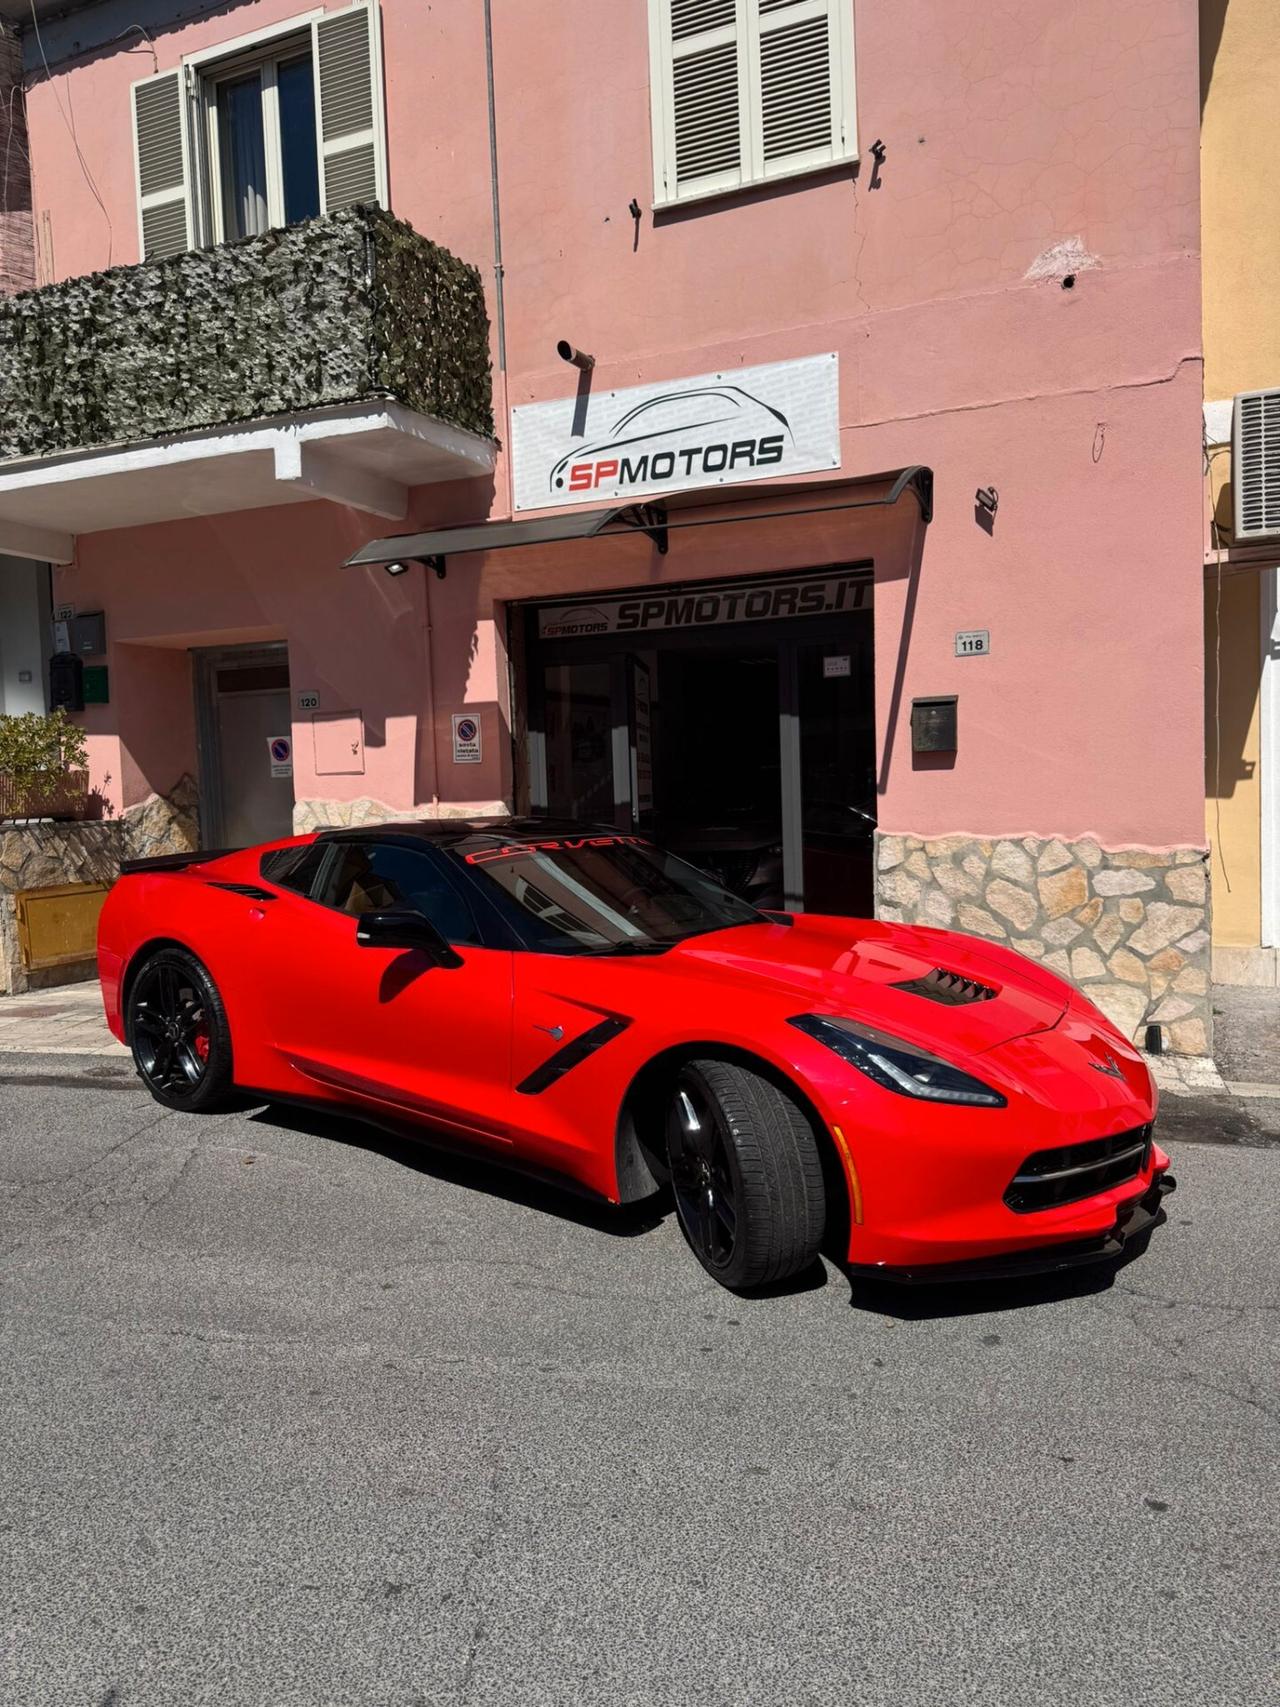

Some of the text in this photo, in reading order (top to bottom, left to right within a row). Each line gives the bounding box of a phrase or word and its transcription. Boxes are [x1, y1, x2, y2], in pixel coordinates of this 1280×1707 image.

[569, 435, 784, 491] SPMOTORS
[616, 579, 872, 630] SPMOTORS.IT
[546, 622, 608, 636] SPMOTORS
[962, 639, 983, 651] 118
[301, 698, 317, 707] 120
